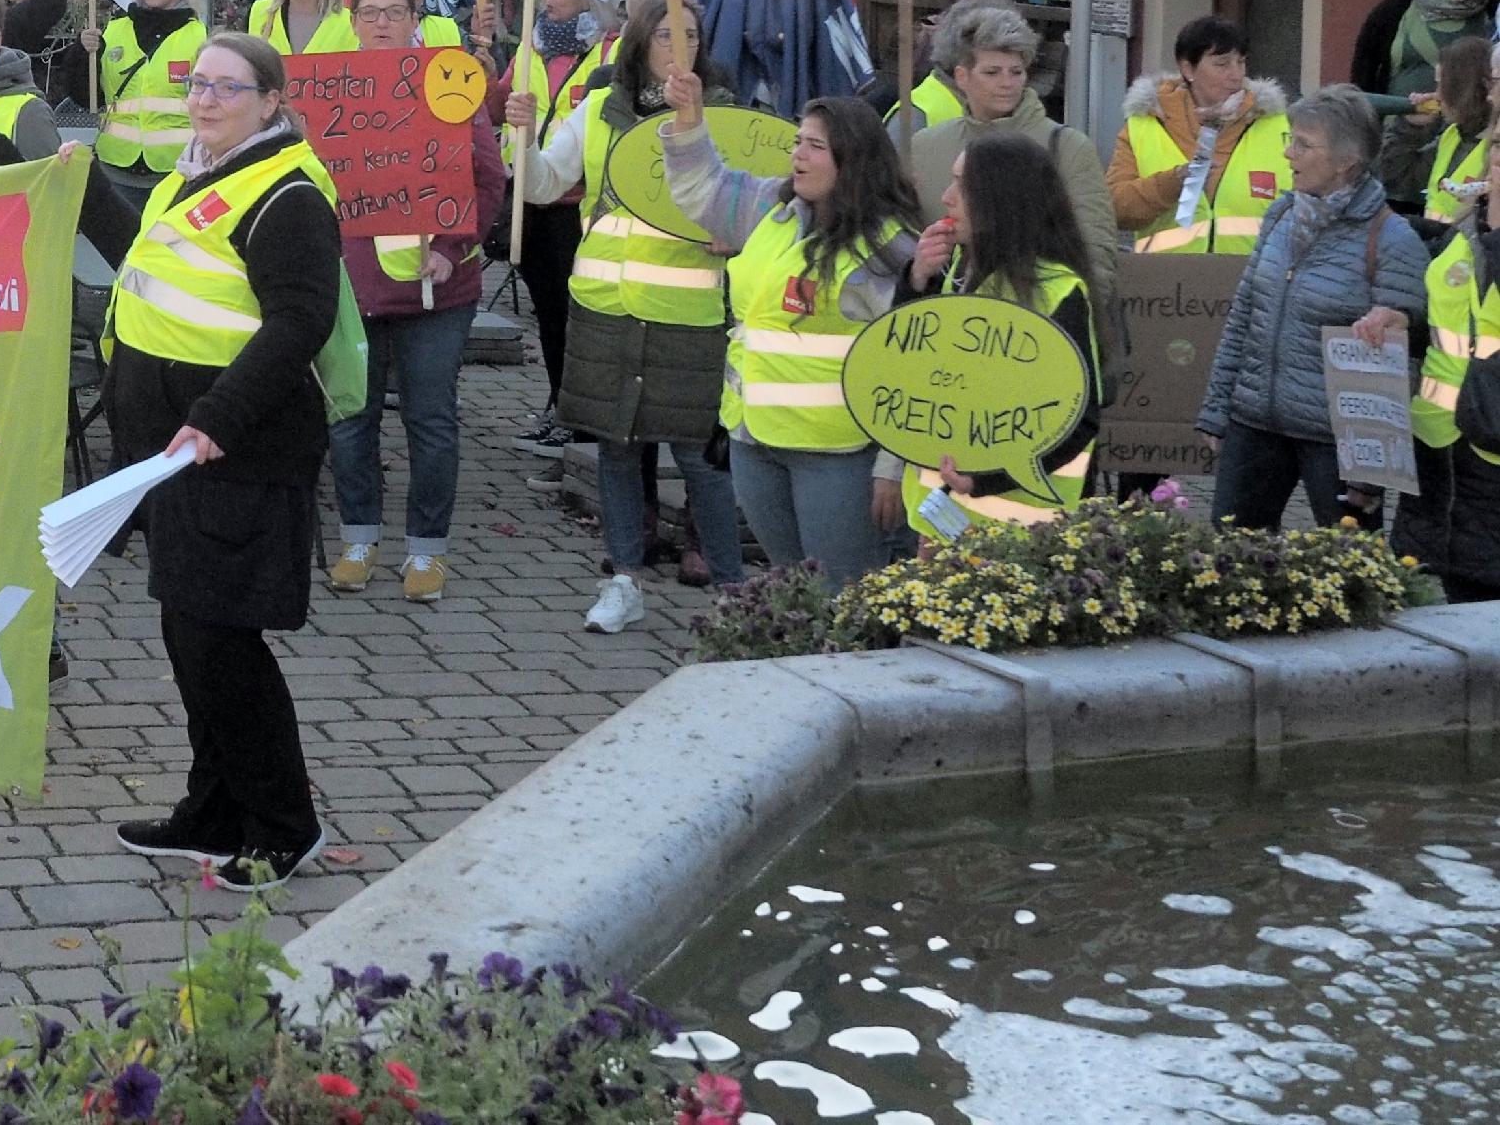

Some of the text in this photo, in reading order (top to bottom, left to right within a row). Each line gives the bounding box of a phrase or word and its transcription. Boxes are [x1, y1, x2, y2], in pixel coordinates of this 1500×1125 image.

[394, 55, 421, 100] &
[884, 311, 1040, 363] WIR SIND
[871, 386, 957, 440] PREIS
[969, 400, 1060, 448] WERT
